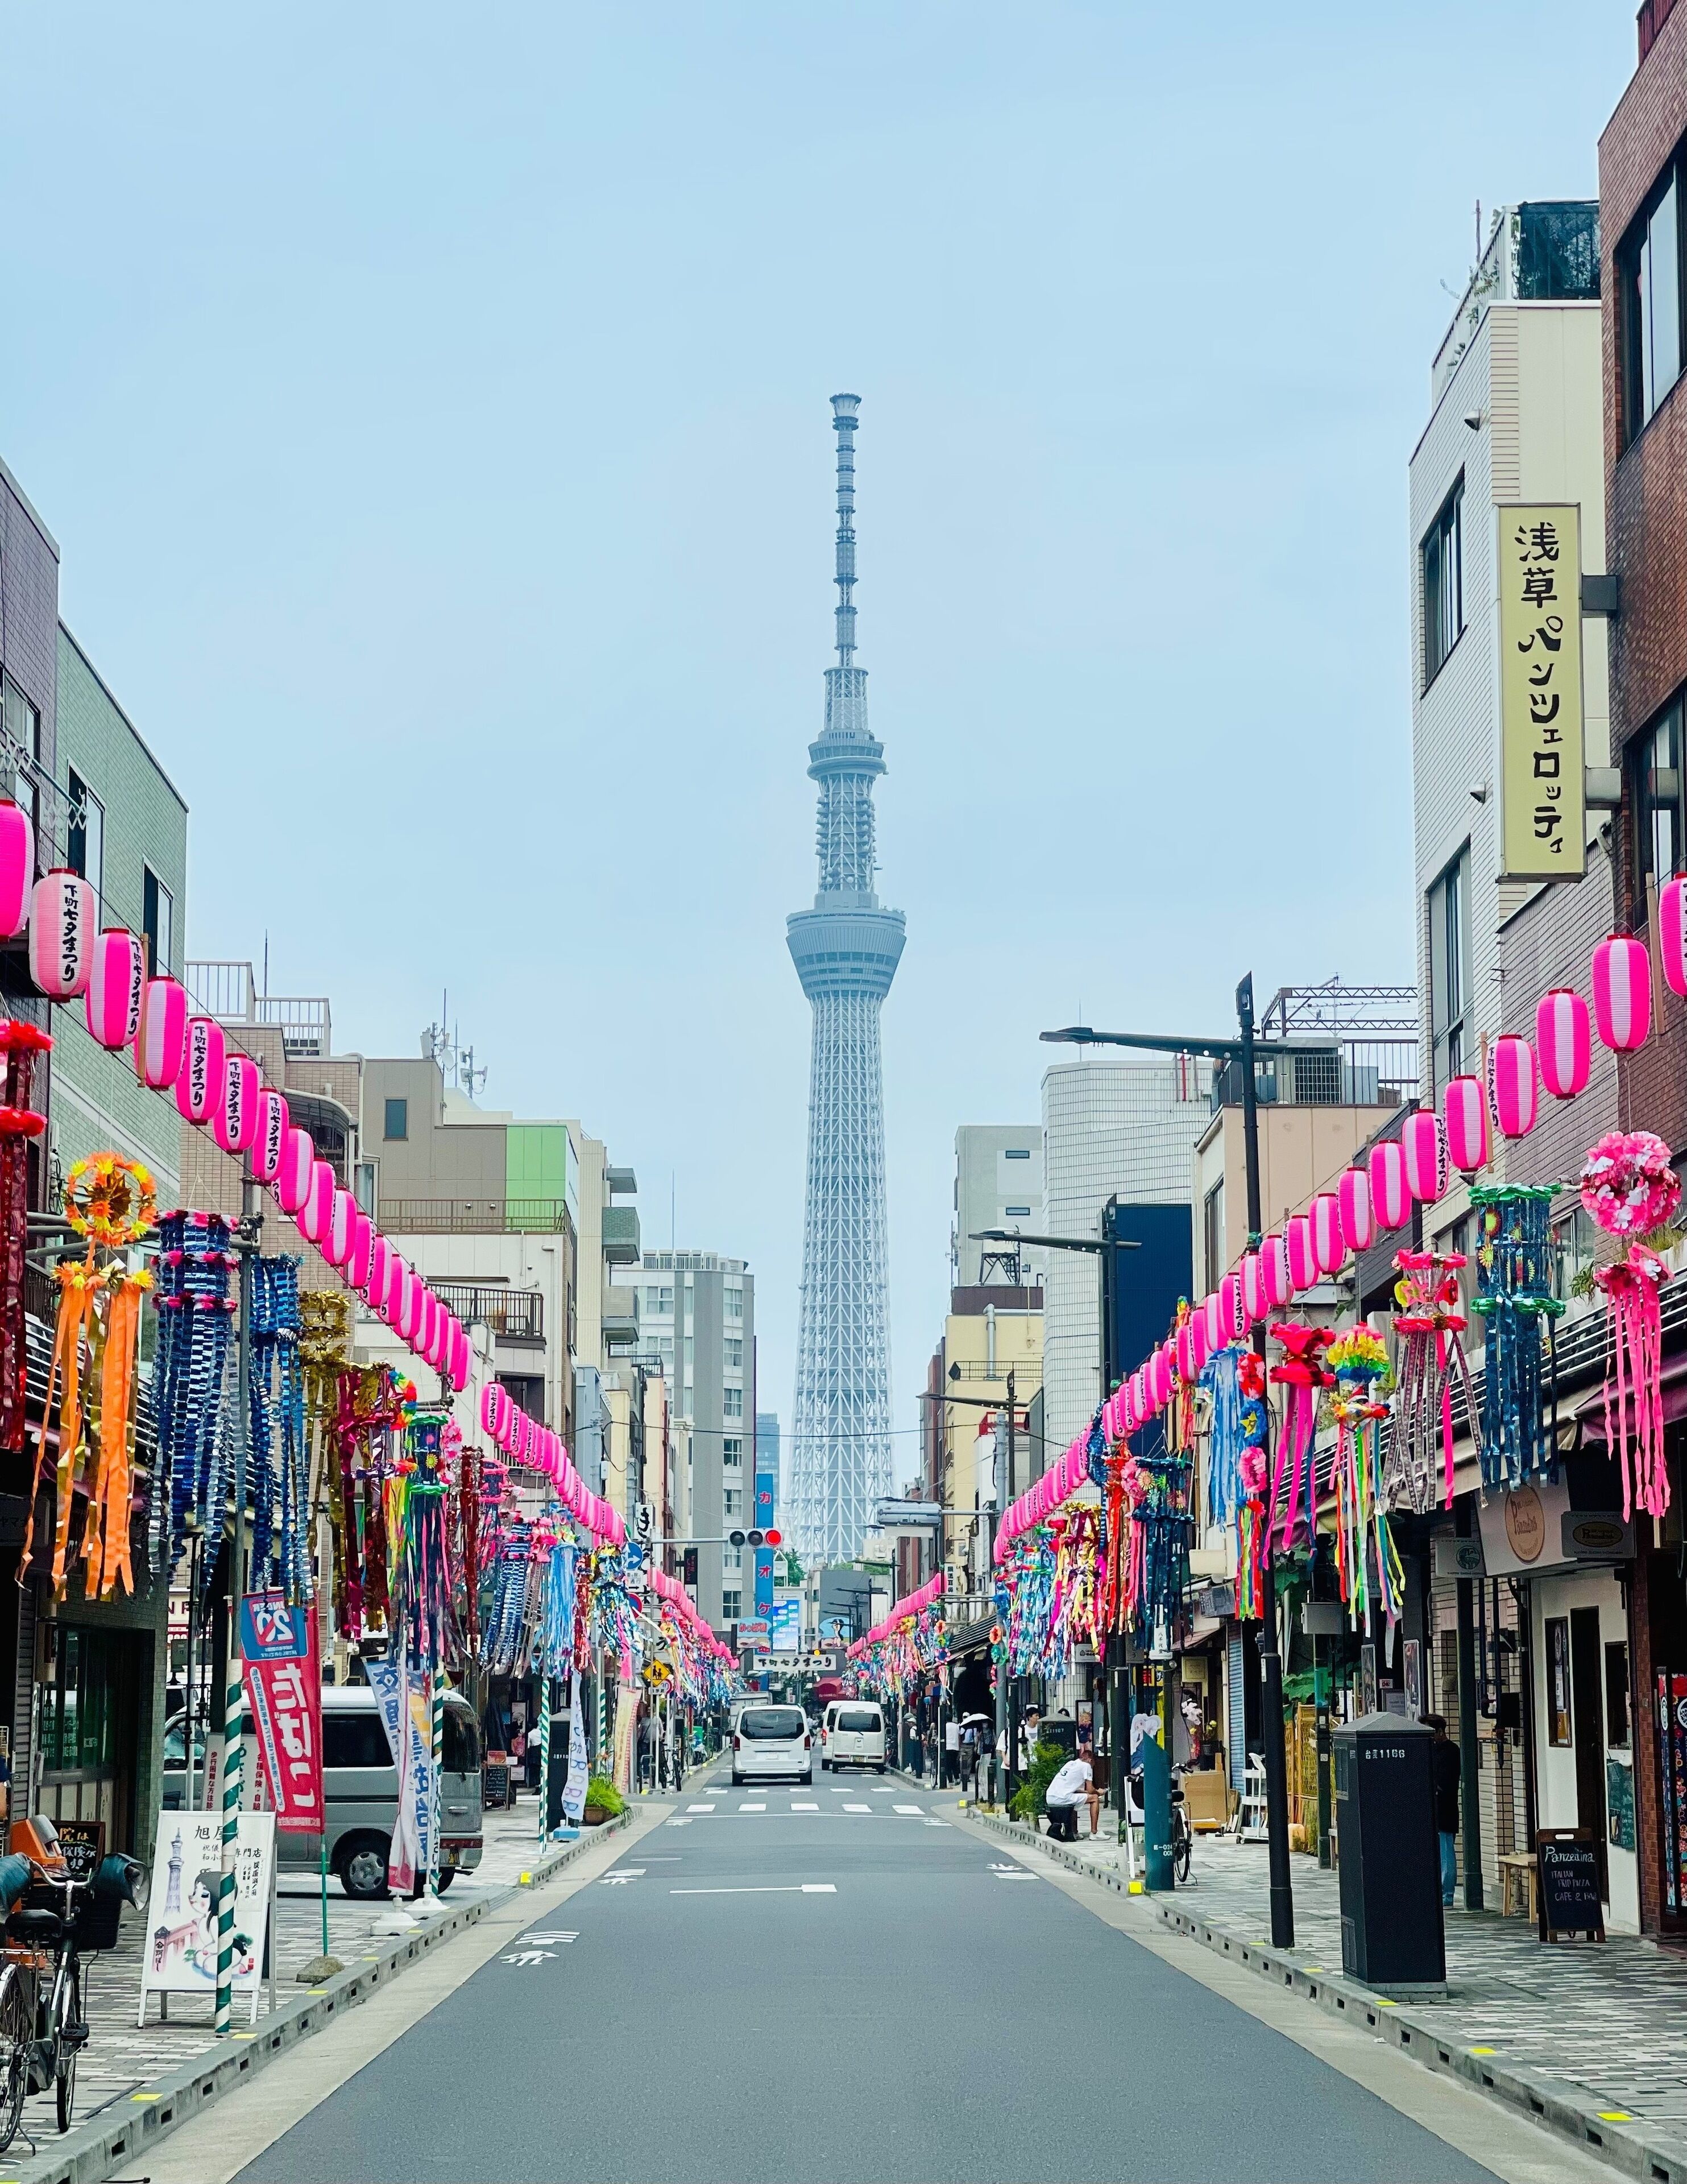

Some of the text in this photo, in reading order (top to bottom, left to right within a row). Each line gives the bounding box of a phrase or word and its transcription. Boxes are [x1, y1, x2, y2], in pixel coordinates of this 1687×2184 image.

[1514, 521, 1564, 854] 浅草パンツェロッティ
[63, 884, 79, 983] 下町七夕まつり
[192, 1026, 206, 1107] 下町七夕まつり
[227, 1061, 242, 1139] 下町七夕まつり
[267, 1097, 281, 1170] 下町七夕まつり
[1235, 1279, 1244, 1332] 下町七夕まつり
[758, 1656, 832, 1667] 下町七夕まつり
[206, 1752, 218, 1811] 歩行困難な方往診
[1555, 1893, 1572, 1901] CAFE
